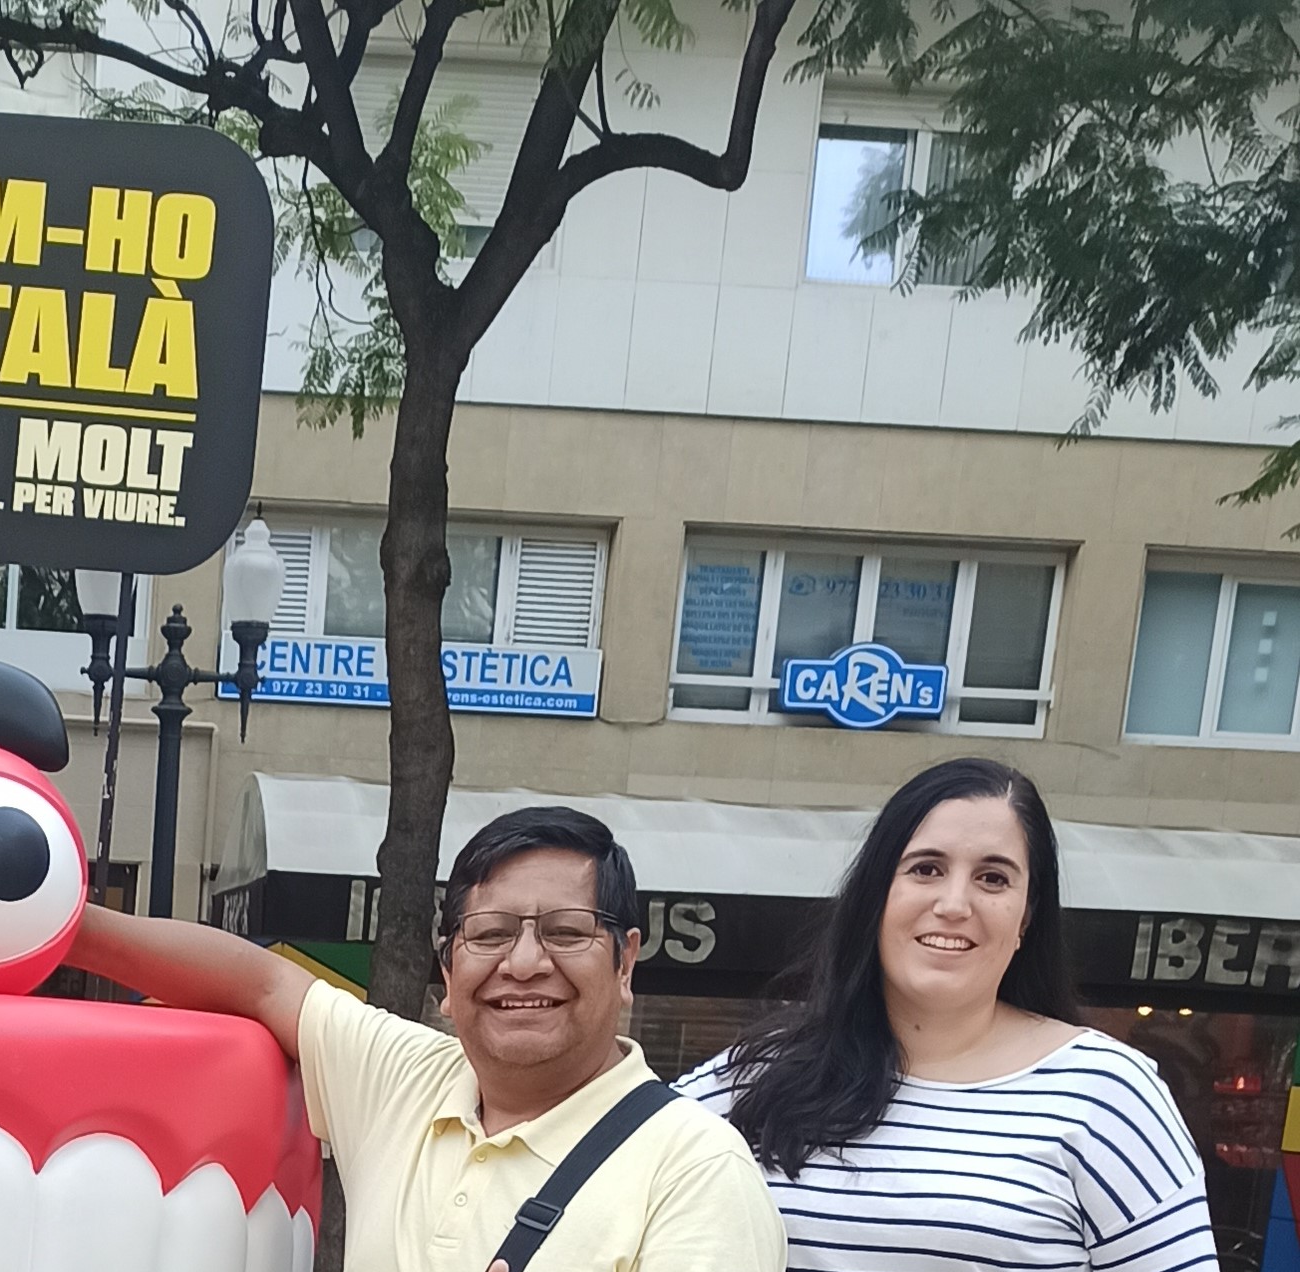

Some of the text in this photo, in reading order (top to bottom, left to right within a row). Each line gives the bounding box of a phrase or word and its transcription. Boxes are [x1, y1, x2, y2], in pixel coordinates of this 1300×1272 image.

[16, 417, 193, 492] MOLT
[13, 482, 186, 527] PER VIURE.
[441, 648, 573, 687] STÈTICA
[272, 681, 299, 694] 977
[305, 683, 323, 695] 23
[329, 684, 346, 696] 30
[353, 685, 370, 698] 31
